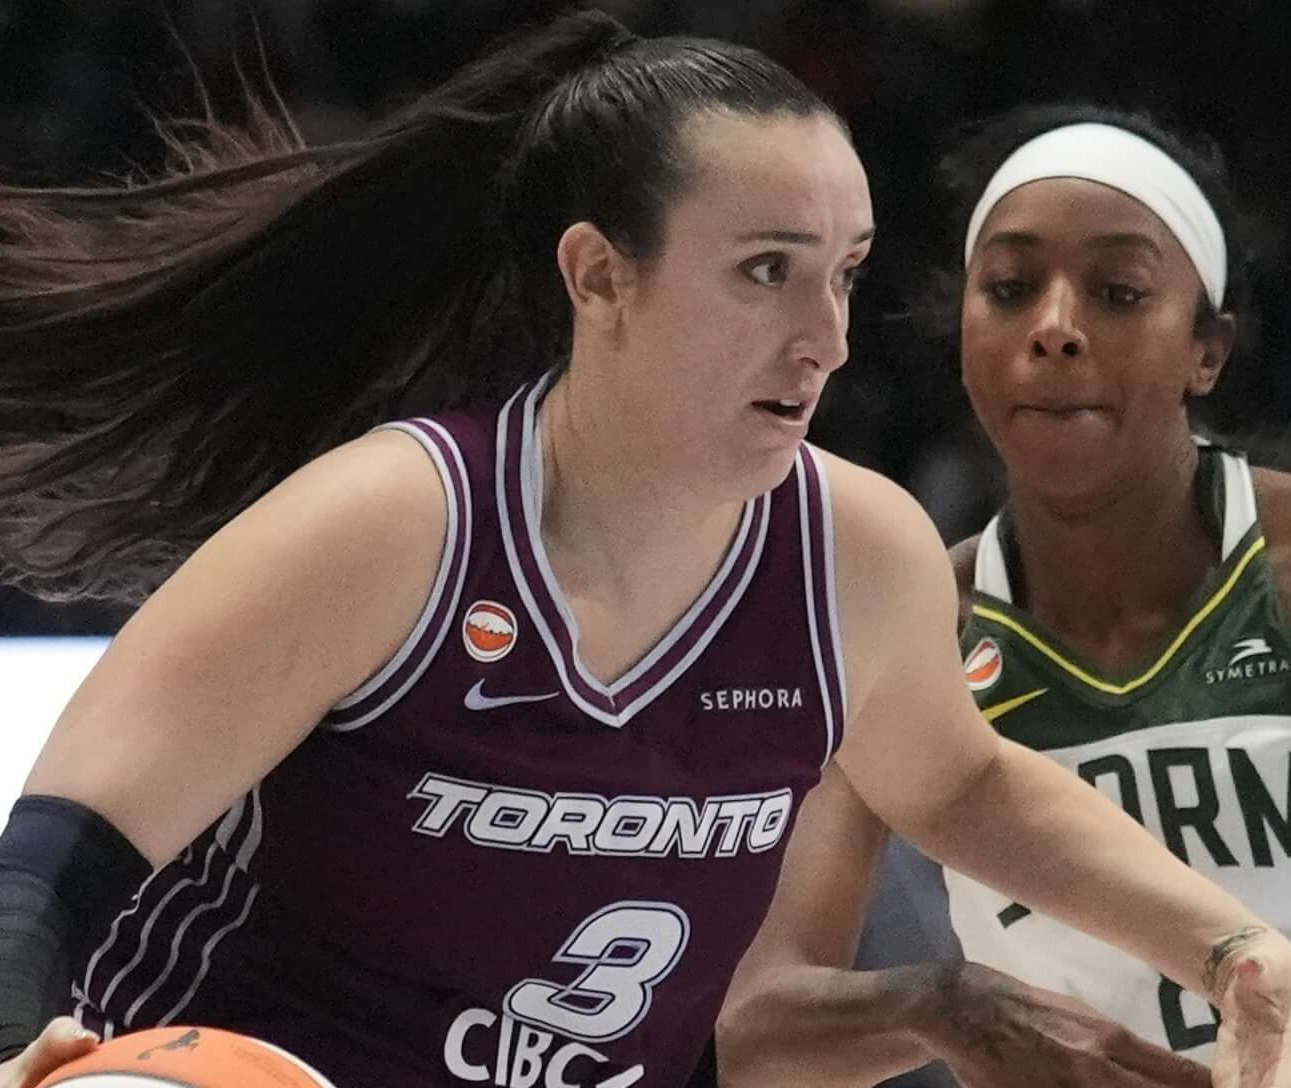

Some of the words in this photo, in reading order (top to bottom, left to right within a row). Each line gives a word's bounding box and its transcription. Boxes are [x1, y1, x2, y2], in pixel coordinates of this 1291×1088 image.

[700, 688, 803, 710] SEPHORA
[1205, 659, 1290, 684] SYMETRA
[407, 771, 793, 859] TORONTO
[503, 900, 691, 1043] 3
